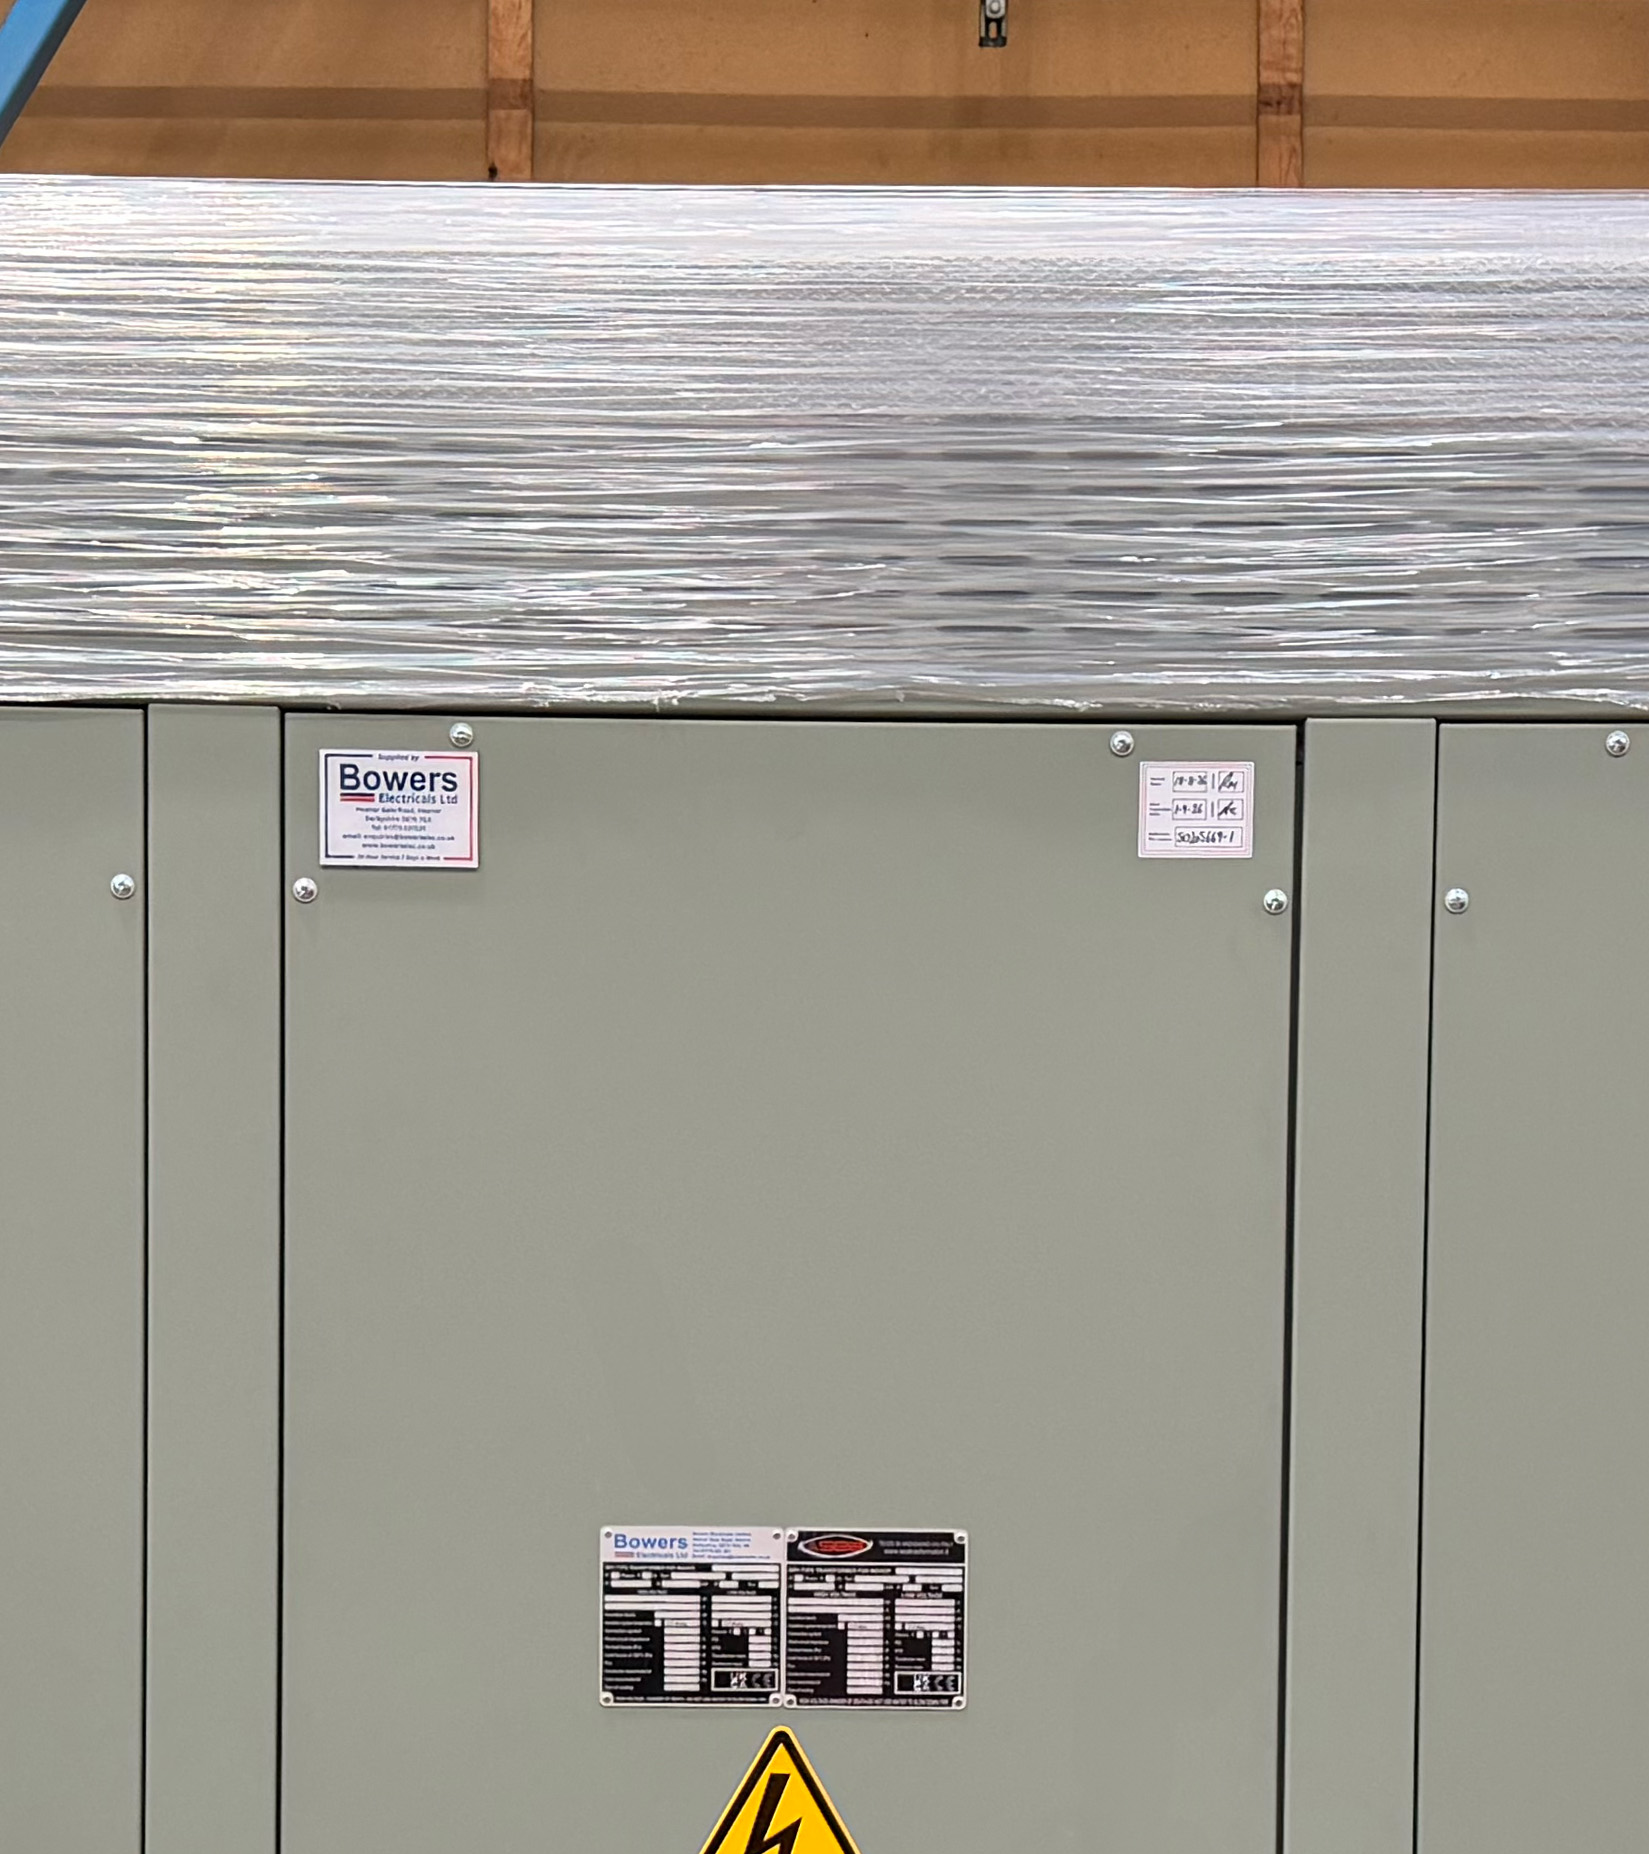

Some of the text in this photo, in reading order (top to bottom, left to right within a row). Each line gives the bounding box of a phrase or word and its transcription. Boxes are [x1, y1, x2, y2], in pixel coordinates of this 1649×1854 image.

[340, 764, 458, 792] Bowers
[378, 793, 458, 805] Electricals Ltd
[614, 1534, 688, 1549] Bowers
